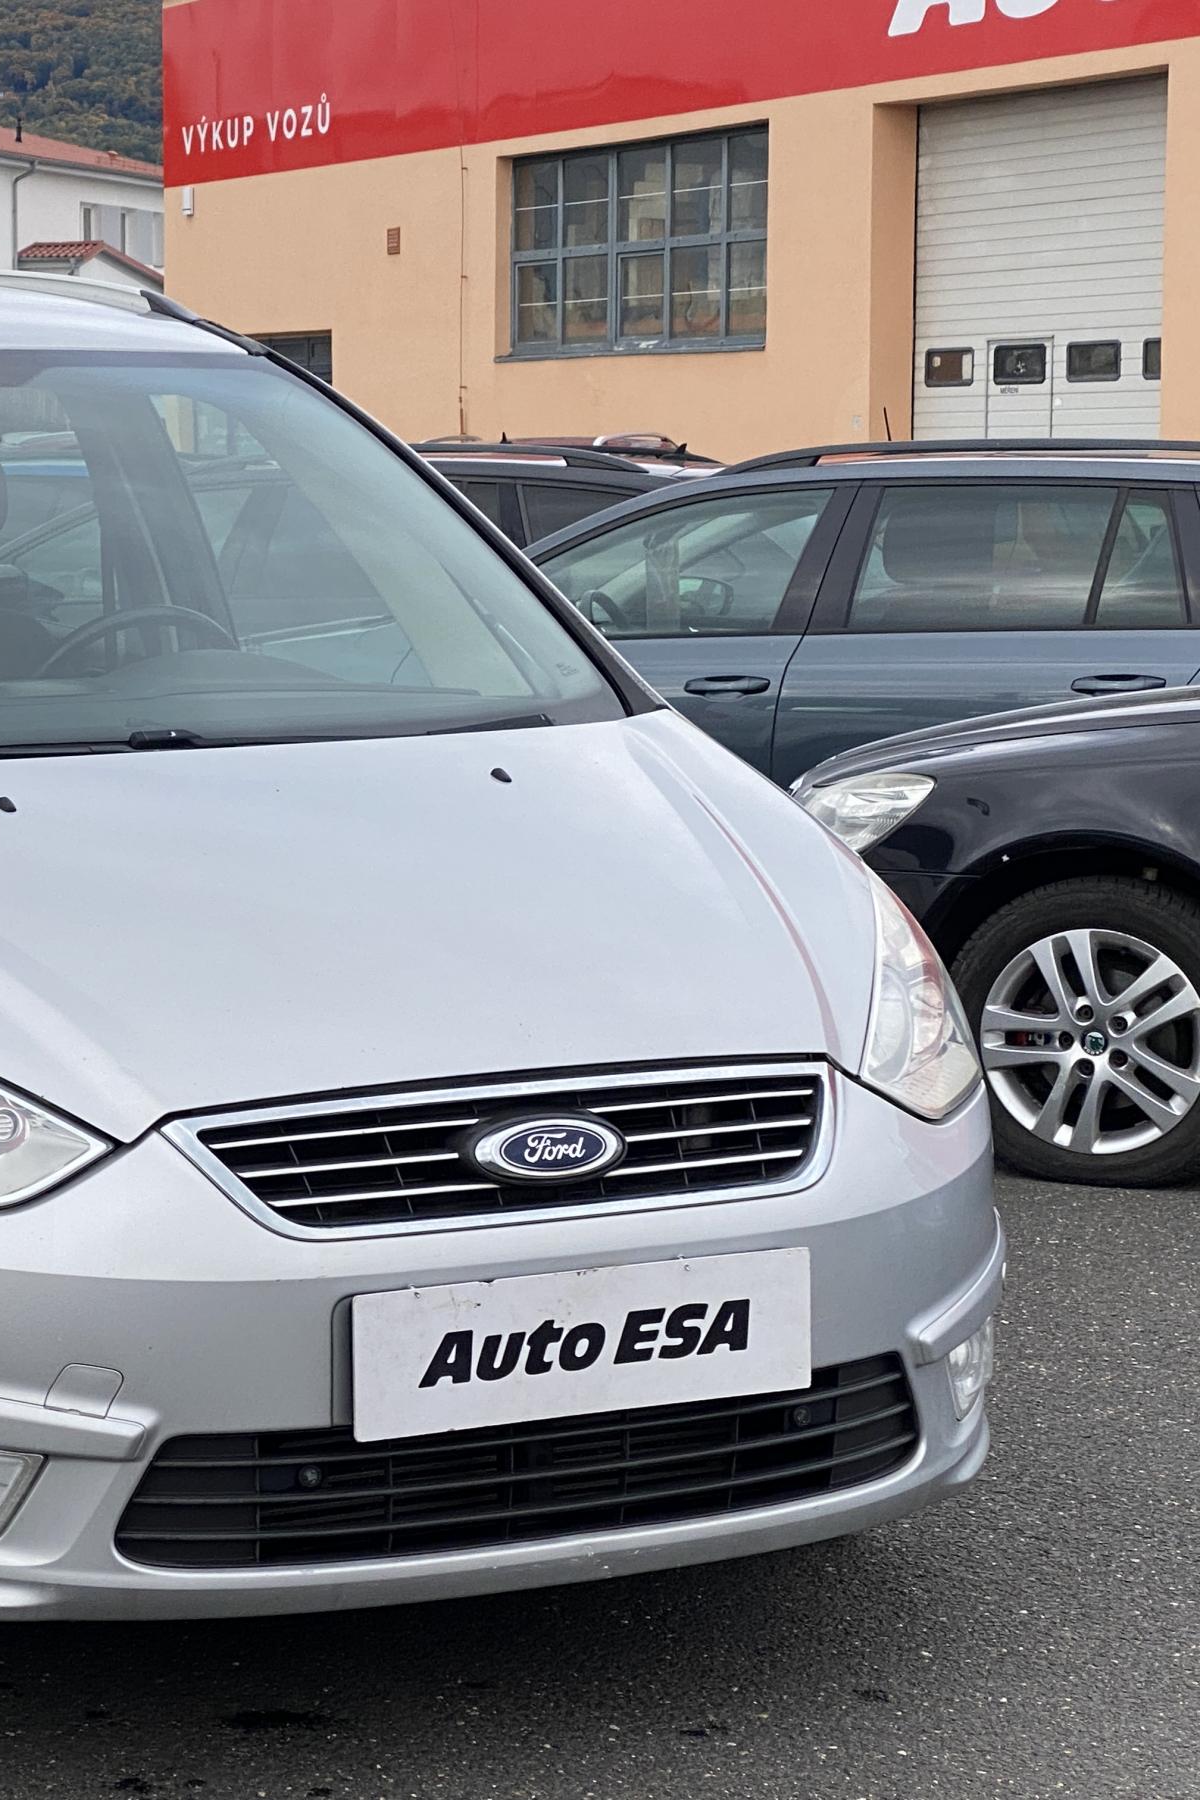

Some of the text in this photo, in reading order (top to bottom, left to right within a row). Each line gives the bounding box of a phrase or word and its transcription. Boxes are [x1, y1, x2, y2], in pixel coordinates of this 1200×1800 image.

[182, 93, 330, 155] VÝKUP VOZŮ
[524, 1132, 586, 1163] Ford
[418, 1299, 750, 1388] Auto ESA
